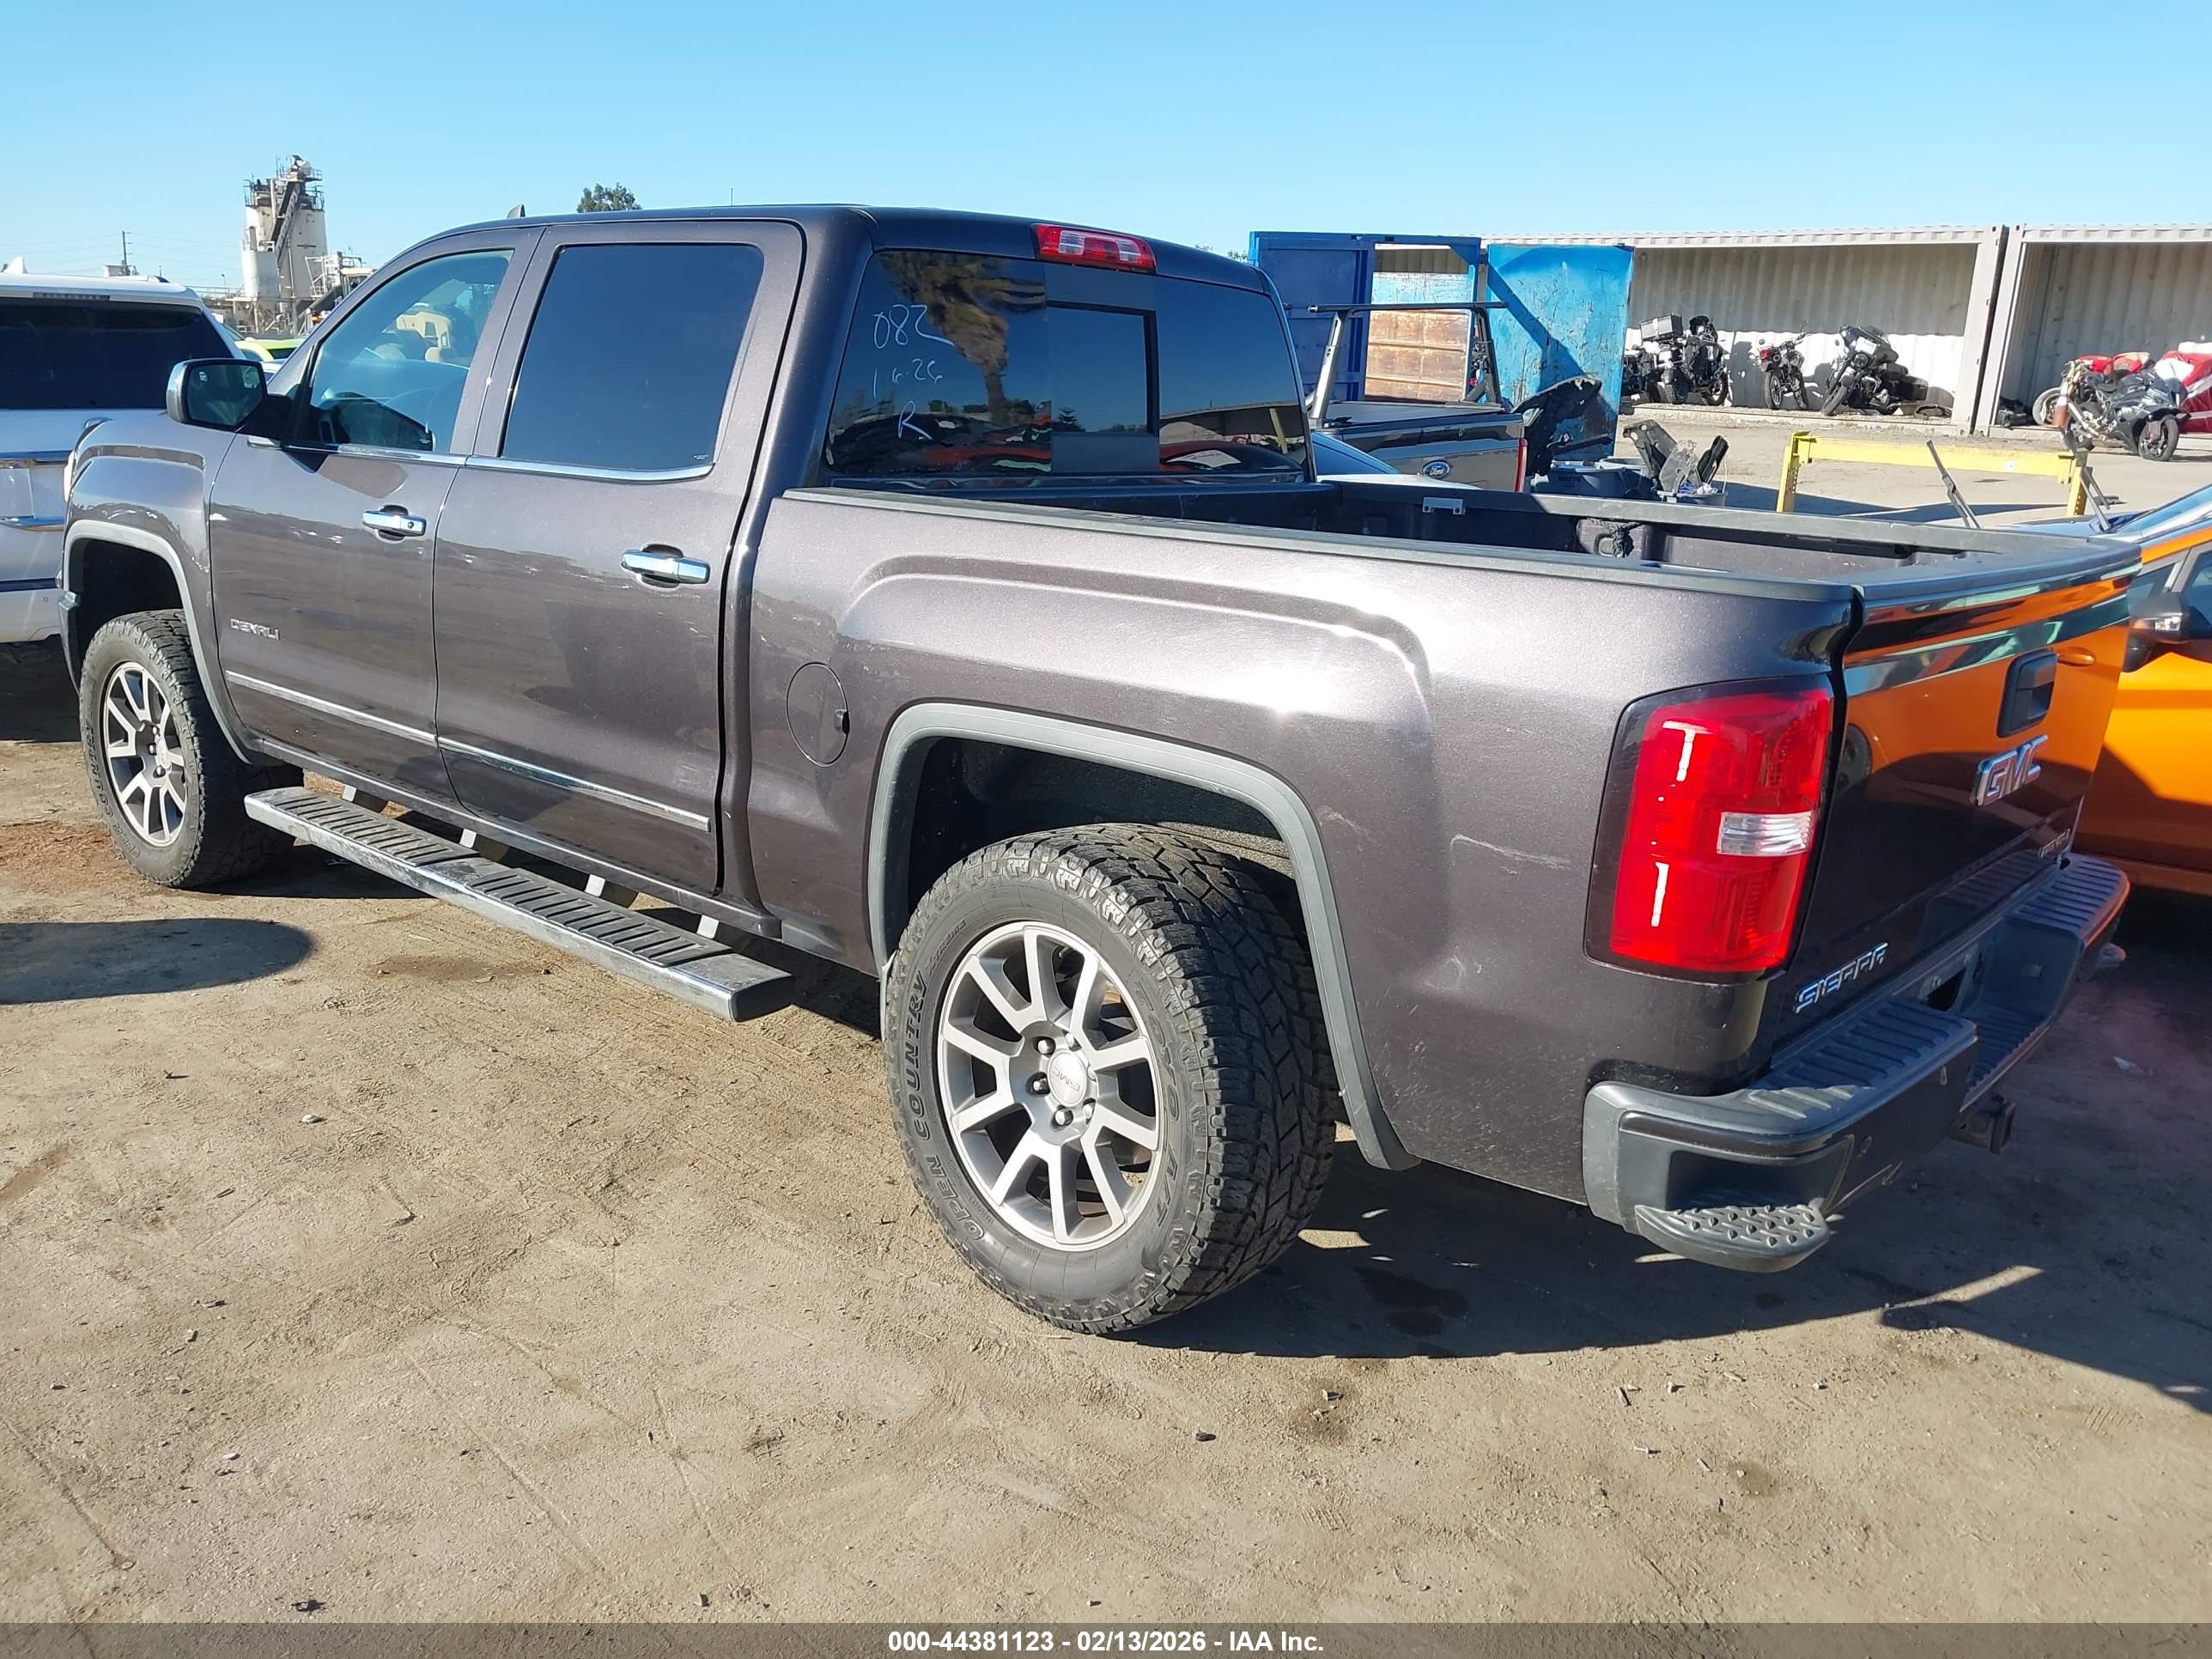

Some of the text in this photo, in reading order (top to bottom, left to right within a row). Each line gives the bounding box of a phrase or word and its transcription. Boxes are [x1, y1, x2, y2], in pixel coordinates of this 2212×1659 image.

[873, 304, 955, 349] 082
[897, 400, 933, 441] R
[1976, 734, 2049, 807] GMC
[1796, 942, 1888, 1014] SIERRA
[905, 970, 931, 1141] COUNTRY
[926, 1155, 984, 1240] OPEN
